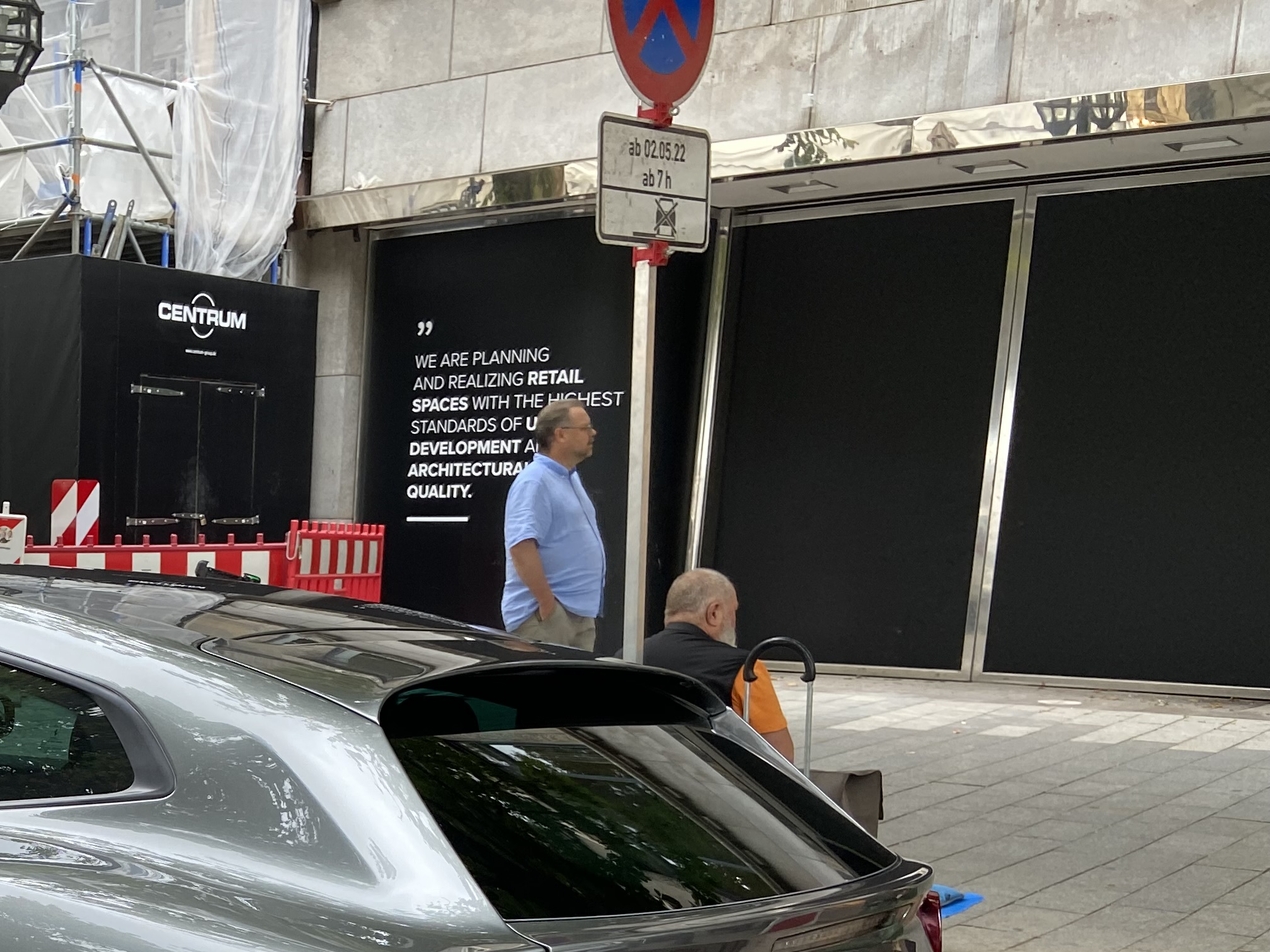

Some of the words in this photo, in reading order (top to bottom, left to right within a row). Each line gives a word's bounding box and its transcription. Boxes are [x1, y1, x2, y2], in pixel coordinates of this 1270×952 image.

[628, 137, 641, 157] ab
[644, 138, 686, 162] 02.05.22
[642, 168, 655, 187] ab
[657, 169, 663, 188] 7
[665, 170, 672, 189] h
[157, 302, 247, 329] CENTRUM
[415, 354, 437, 368] WE
[440, 352, 469, 368] ARE
[472, 347, 550, 366] PLANNING
[413, 376, 445, 391] AND
[448, 372, 524, 389] REALIZING
[527, 368, 584, 386] RETAIL
[411, 396, 468, 413] SPACES
[472, 394, 510, 410] WITH
[514, 393, 544, 409] THE
[410, 417, 497, 434] STANDARDS
[500, 416, 523, 432] OF
[409, 439, 522, 456] DEVELOPMENT
[406, 484, 473, 498] QUALITY.
